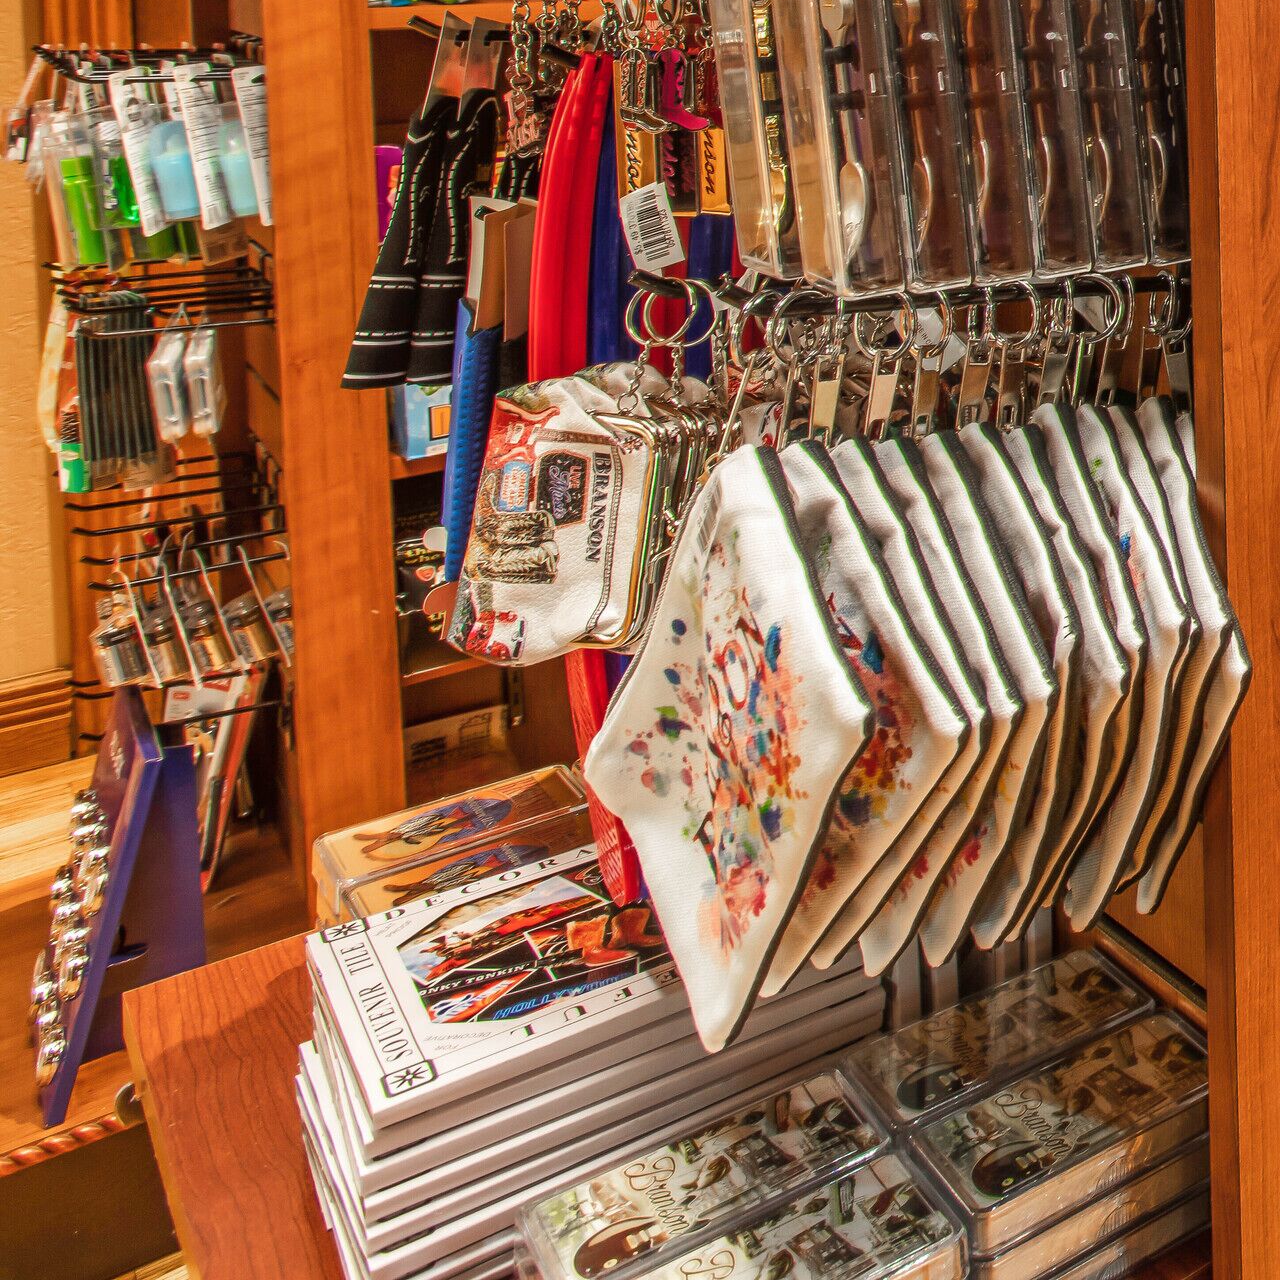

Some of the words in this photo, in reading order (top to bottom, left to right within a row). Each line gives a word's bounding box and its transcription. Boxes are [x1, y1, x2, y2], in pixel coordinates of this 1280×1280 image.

[585, 452, 612, 563] BRANSON
[340, 942, 373, 976] TILE
[359, 981, 414, 1063] SOUVENIR
[995, 1086, 1073, 1158] Branson
[623, 1156, 691, 1236] Branson
